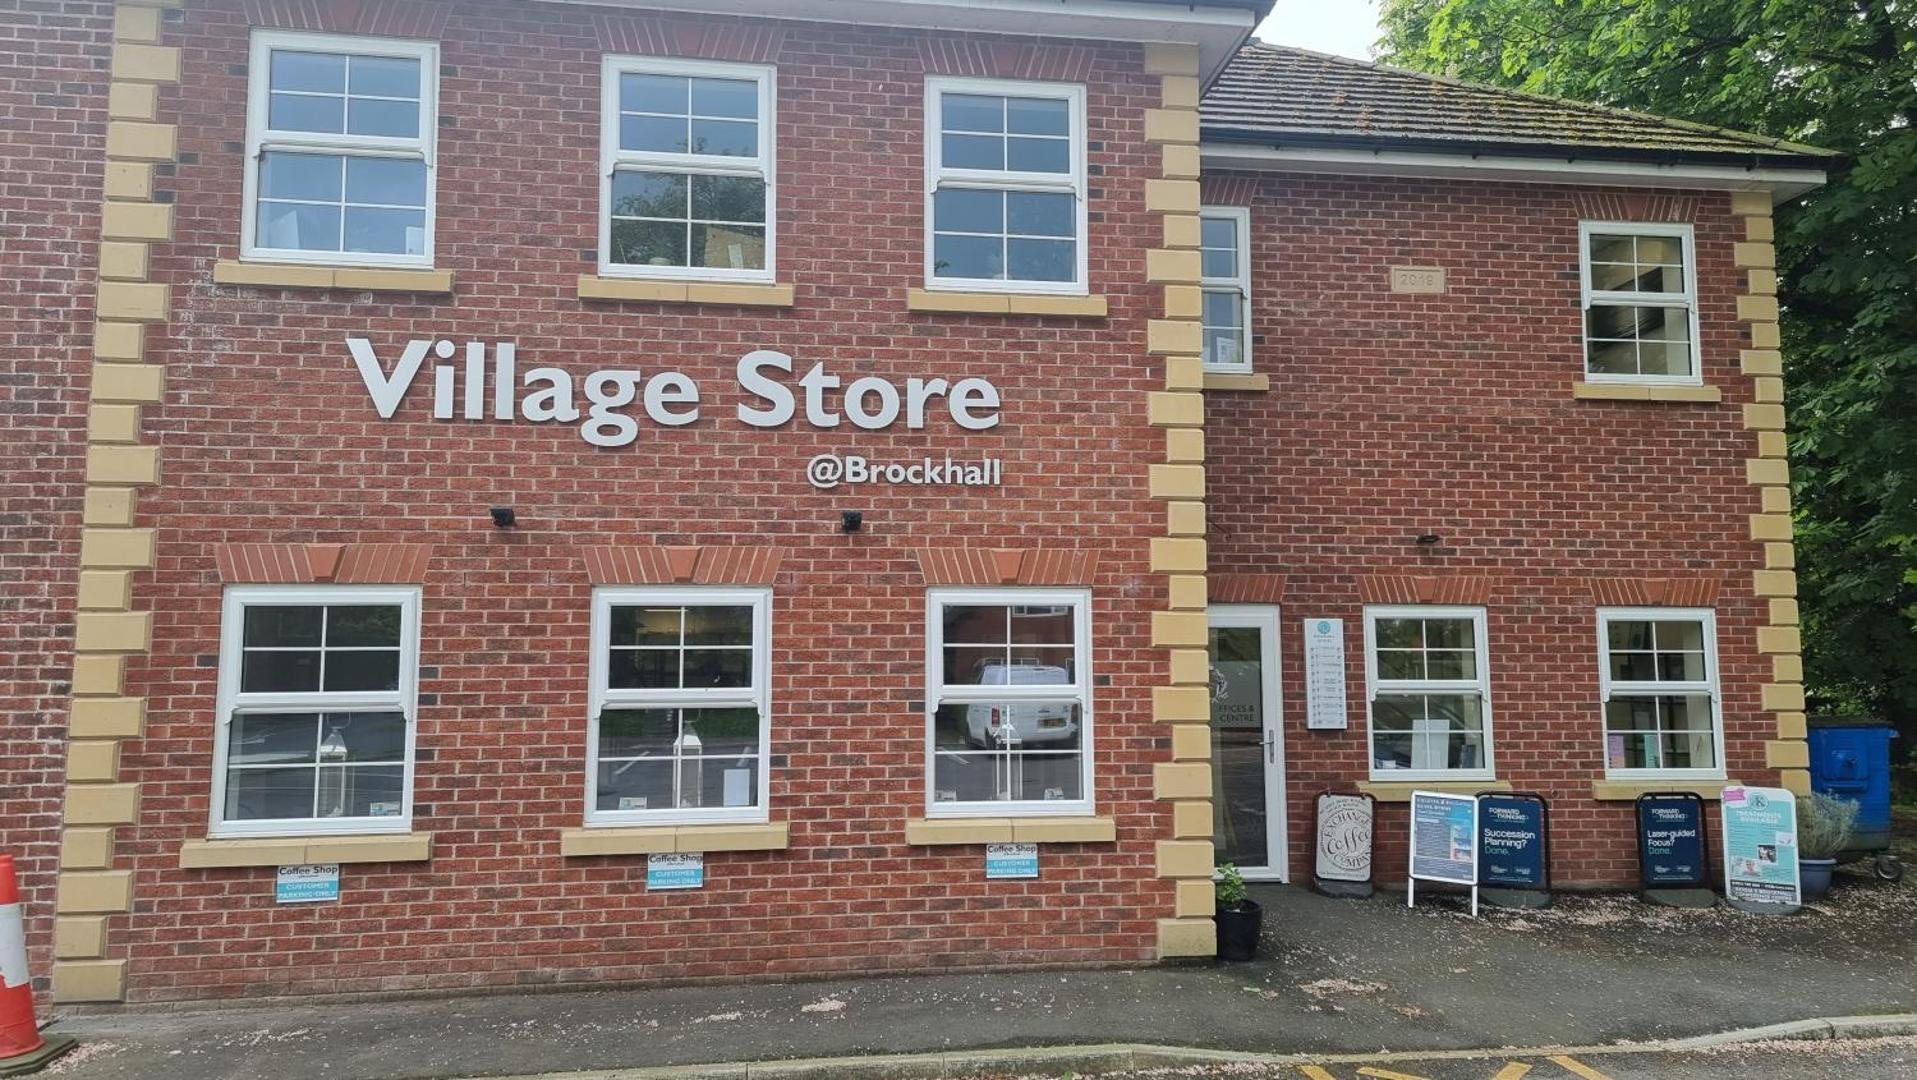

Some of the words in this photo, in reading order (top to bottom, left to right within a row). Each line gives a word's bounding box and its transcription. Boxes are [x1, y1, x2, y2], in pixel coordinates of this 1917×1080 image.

[345, 338, 701, 447] Village
[736, 350, 1001, 429] Store
[806, 454, 1002, 489] @Brockhall
[1219, 713, 1256, 722] CENTRE
[1484, 828, 1537, 840] Succession
[1647, 829, 1696, 840] Laser-guided
[1327, 827, 1371, 855] Coffee
[1485, 837, 1527, 849] Planning?
[1647, 839, 1675, 847] Focus?
[988, 845, 1014, 853] Coffee
[1015, 844, 1036, 854] Shop
[1485, 846, 1510, 855] Done.
[1648, 847, 1672, 855] Done.
[649, 854, 679, 863] Coffee
[681, 853, 703, 863] Shop
[279, 866, 311, 875] Coffee
[313, 865, 338, 875] Shop
